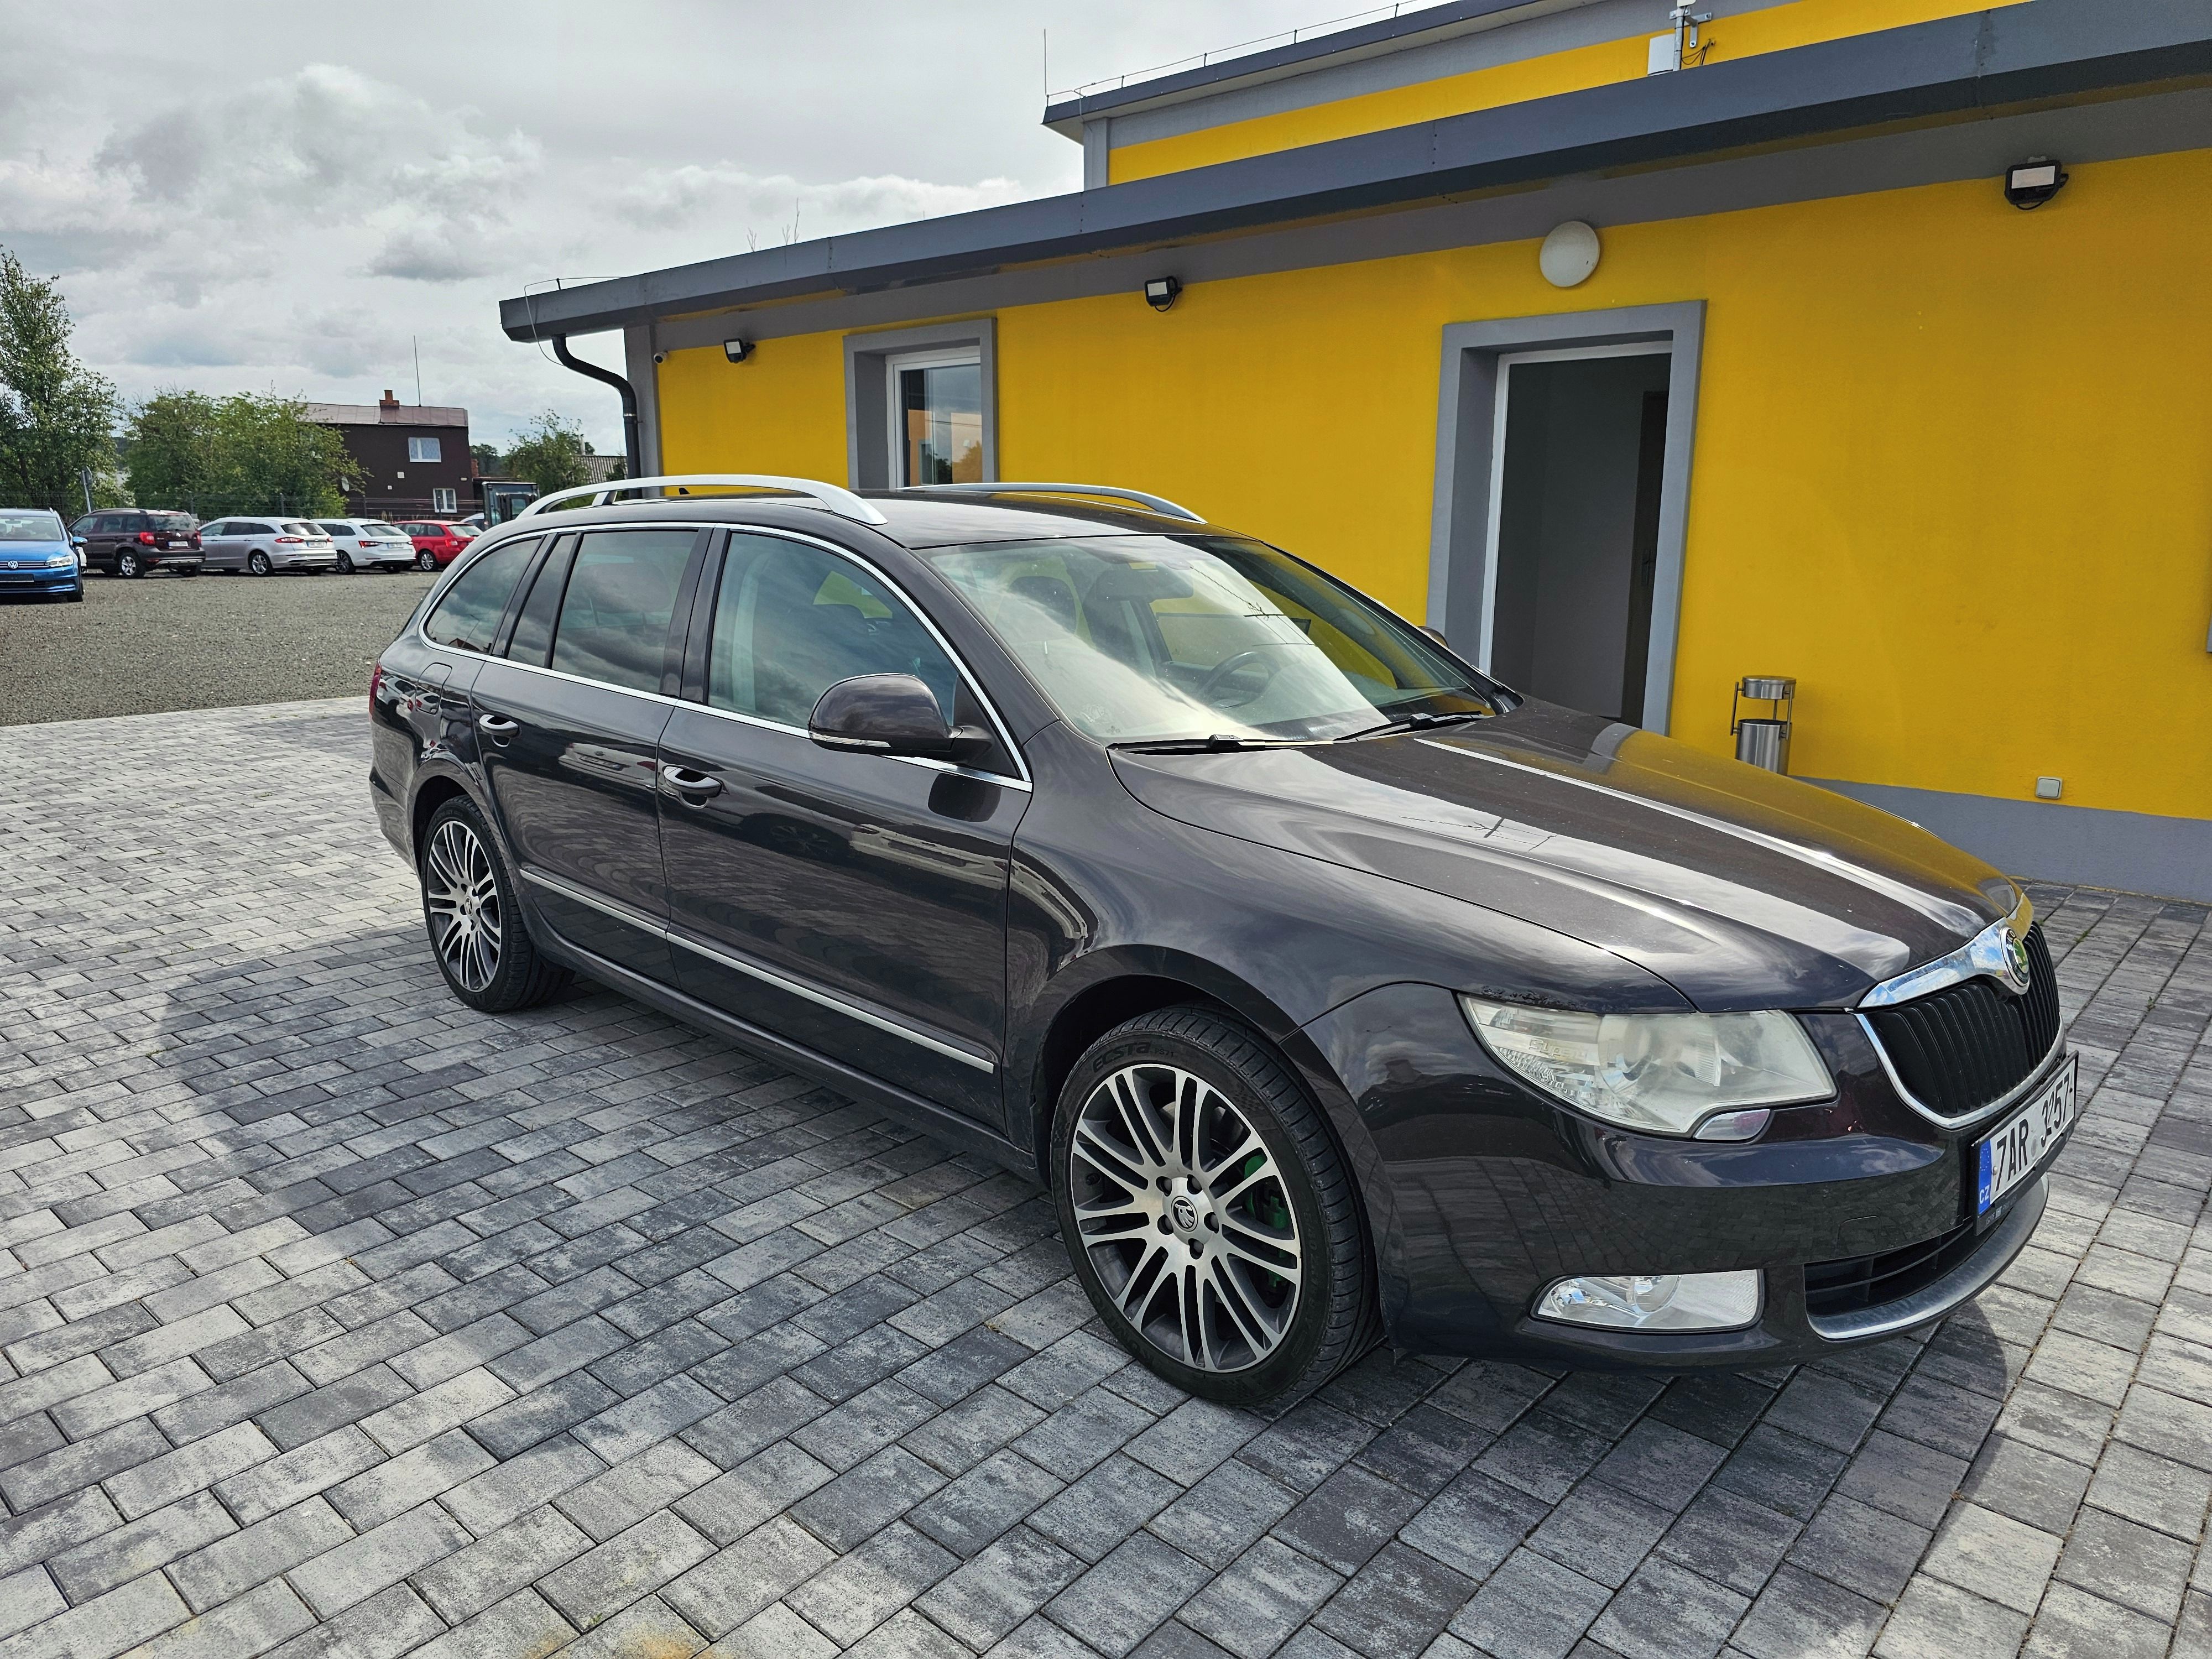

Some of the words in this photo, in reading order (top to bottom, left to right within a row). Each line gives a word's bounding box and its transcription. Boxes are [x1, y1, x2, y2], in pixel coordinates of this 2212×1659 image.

[1154, 1047, 1174, 1057] PS71
[1996, 1119, 2029, 1191] 7AR
[2041, 1072, 2070, 1147] 3257
[1979, 1185, 1990, 1204] CZ
